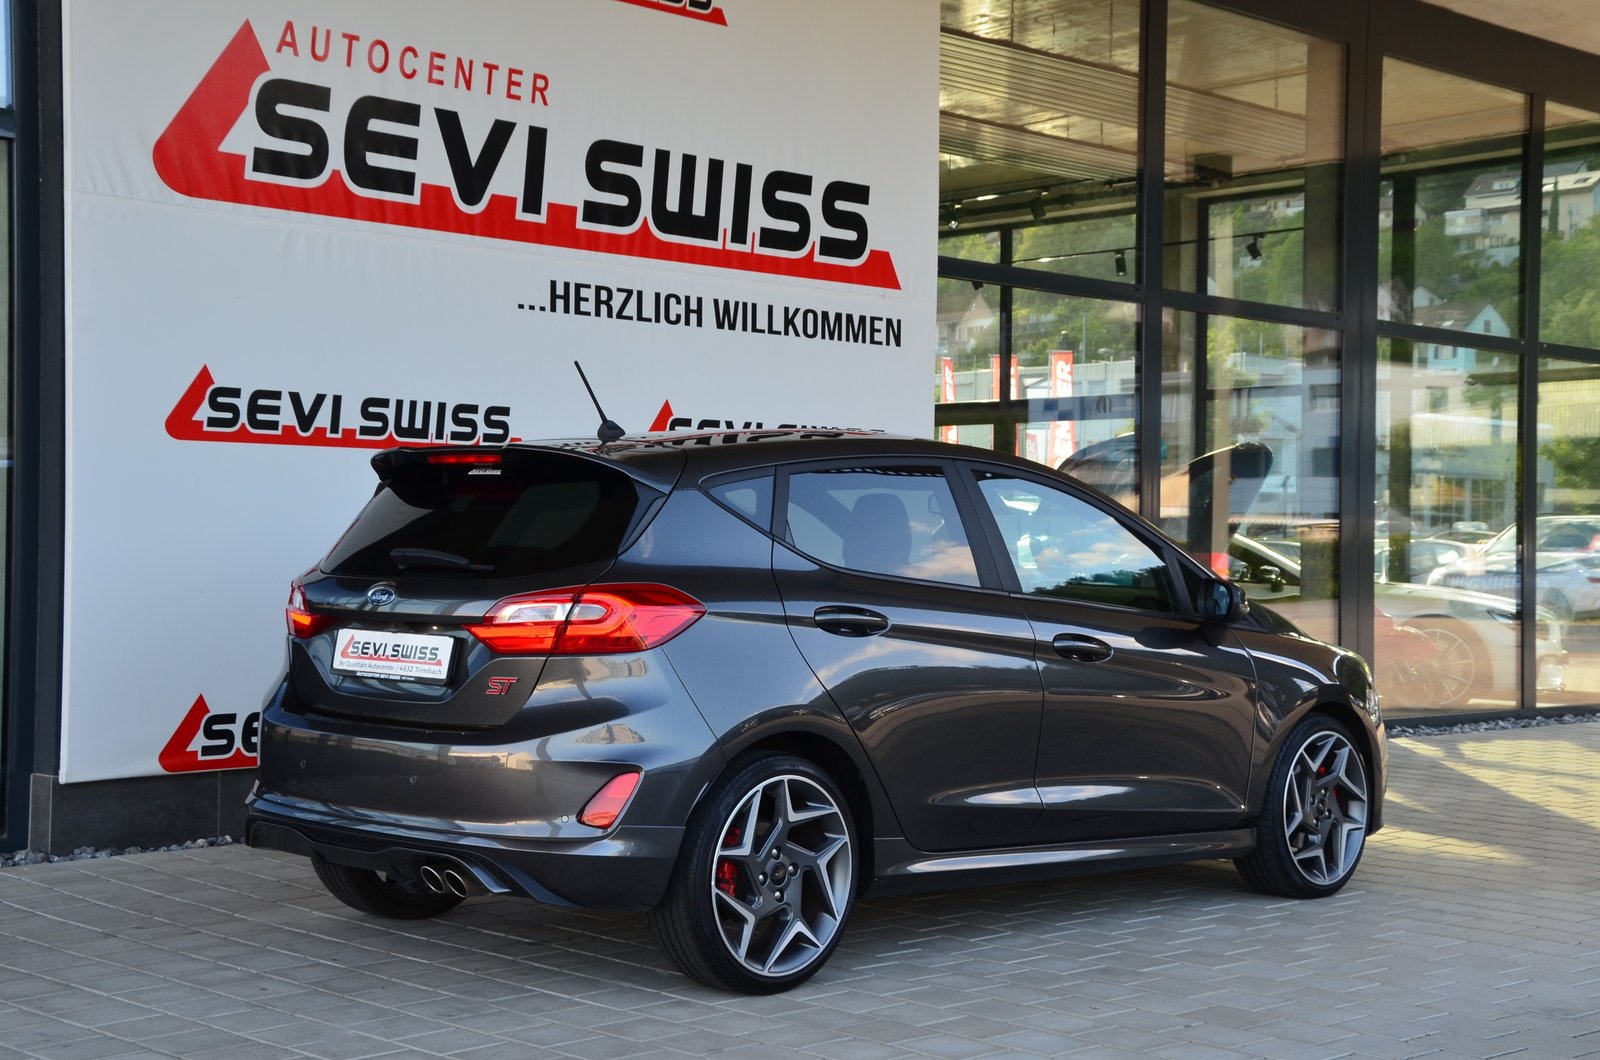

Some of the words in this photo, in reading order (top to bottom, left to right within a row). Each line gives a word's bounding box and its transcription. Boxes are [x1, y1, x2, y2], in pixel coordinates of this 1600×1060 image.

[276, 20, 550, 107] AUTOCENTER
[252, 78, 548, 217] SEVI
[581, 139, 871, 260] SWISS
[712, 298, 902, 348] WILLKOMMEN
[206, 386, 343, 434] SEVI
[358, 396, 511, 443] SWISS
[350, 640, 388, 657] SEVI
[390, 643, 440, 661] SWISS
[368, 662, 395, 671] Autocenter
[399, 665, 413, 673] 4632
[414, 666, 443, 676] Trimbach
[485, 676, 519, 695] ST
